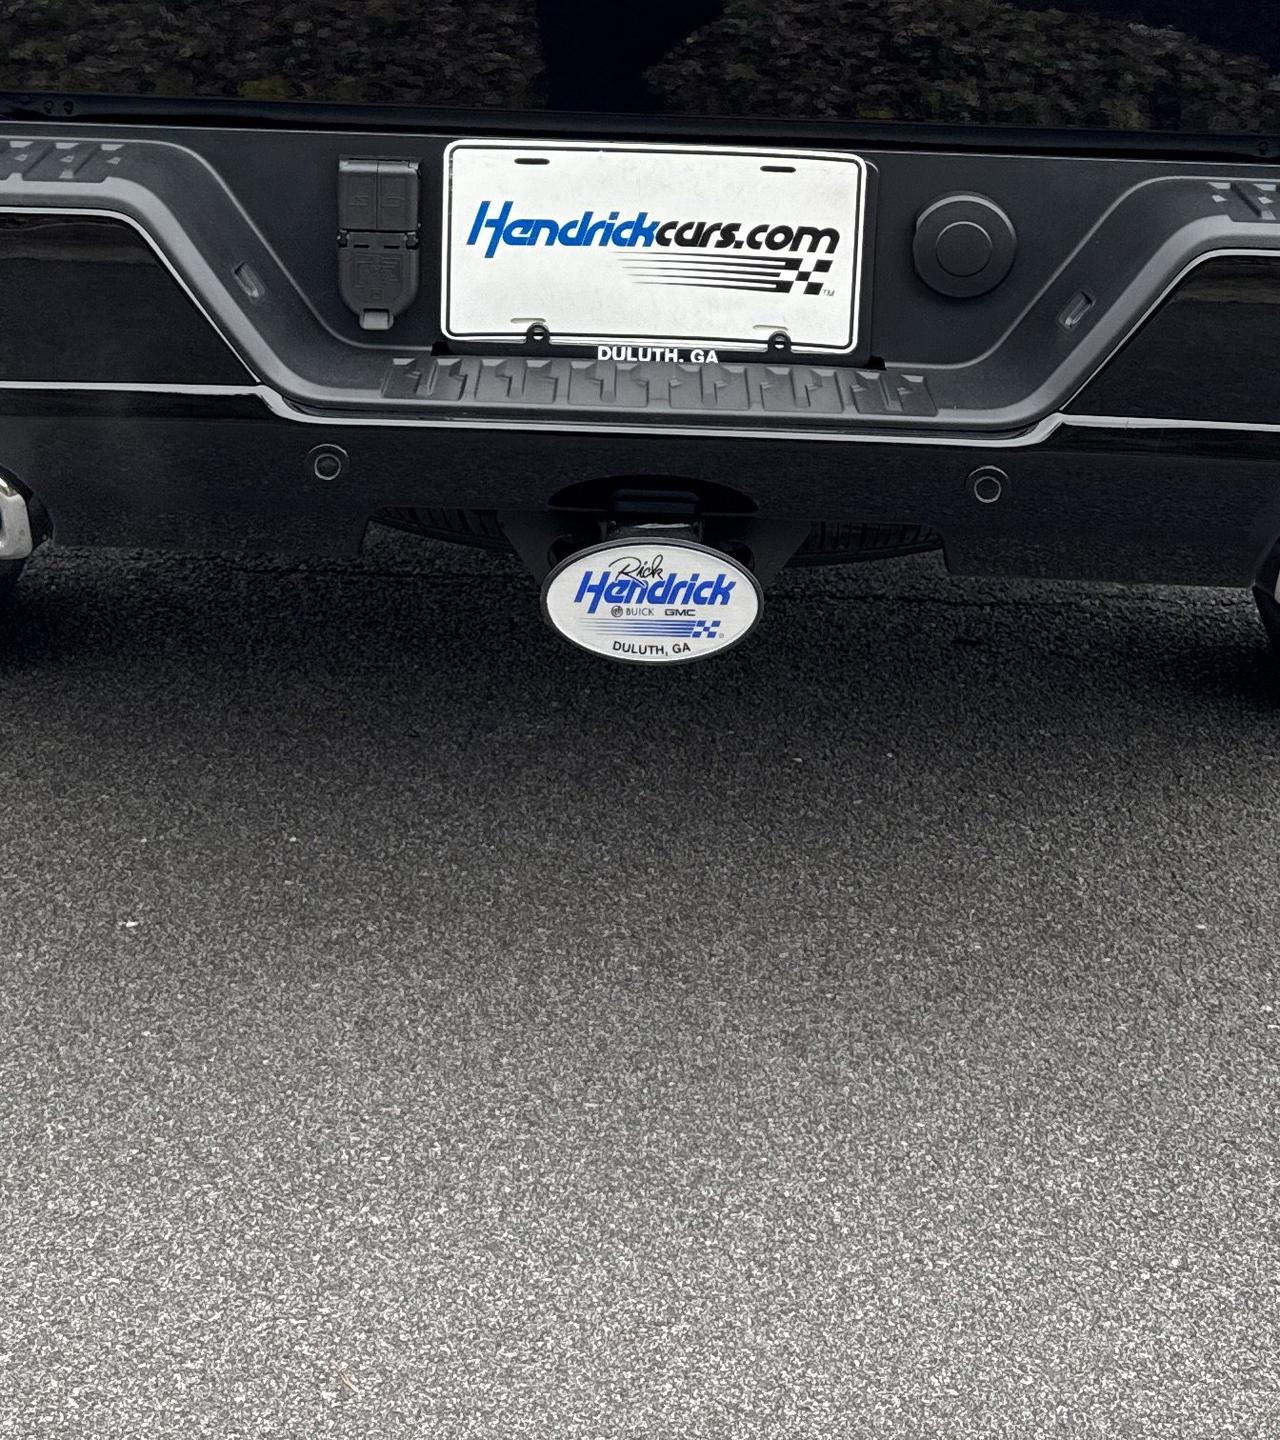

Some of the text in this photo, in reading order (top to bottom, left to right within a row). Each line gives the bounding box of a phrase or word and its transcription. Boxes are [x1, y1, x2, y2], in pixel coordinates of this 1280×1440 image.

[466, 200, 841, 259] Hendrickcars.com
[690, 348, 719, 364] GA
[609, 554, 664, 588] Rick
[574, 571, 737, 614] Hendrick
[626, 607, 696, 617] BUICK GMC
[612, 640, 692, 657] DULUTH, GA
